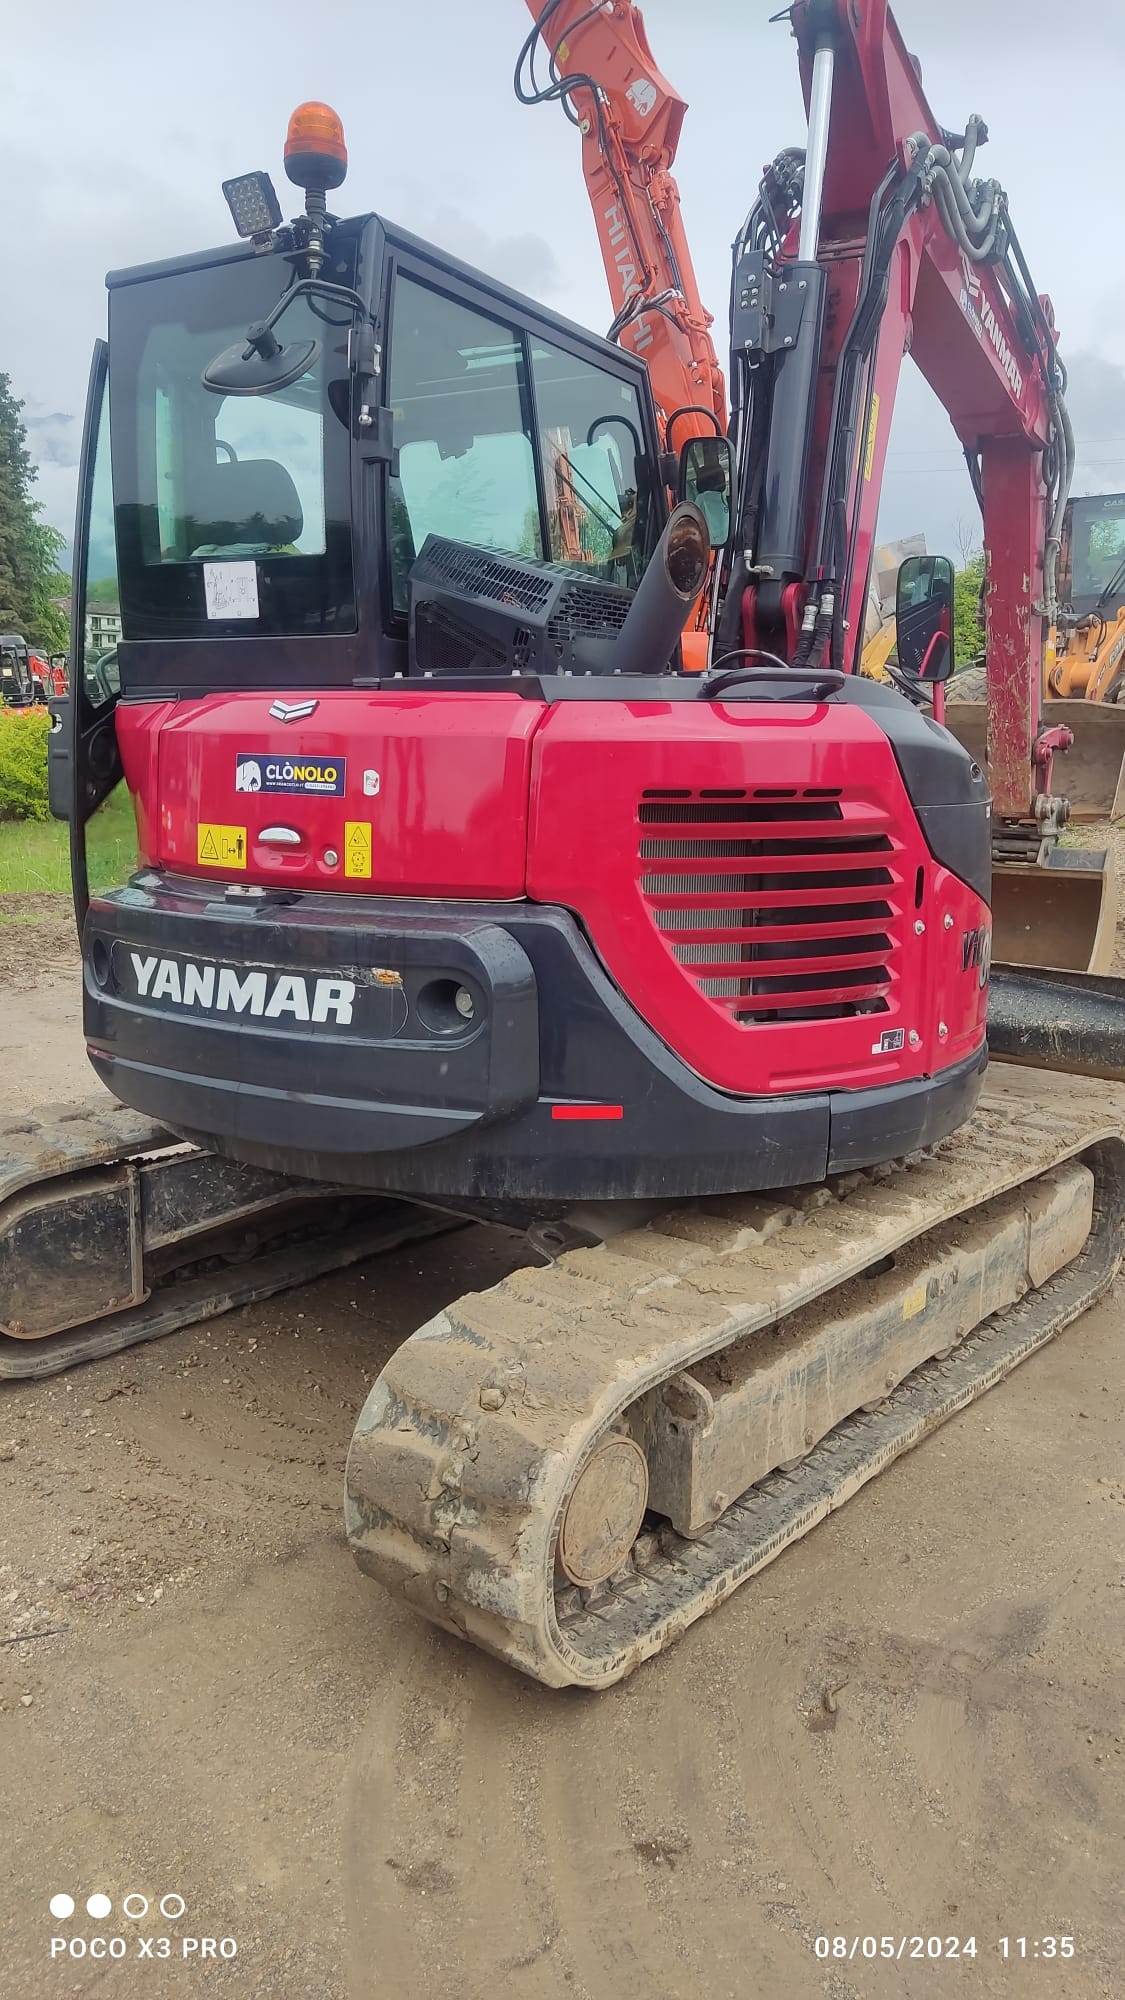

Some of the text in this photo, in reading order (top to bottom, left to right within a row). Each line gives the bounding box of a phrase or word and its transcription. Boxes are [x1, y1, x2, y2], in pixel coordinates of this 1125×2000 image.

[980, 290, 1023, 400] YANMAR
[266, 761, 337, 783] CLÒNOLO
[130, 952, 356, 1025] YANMAR
